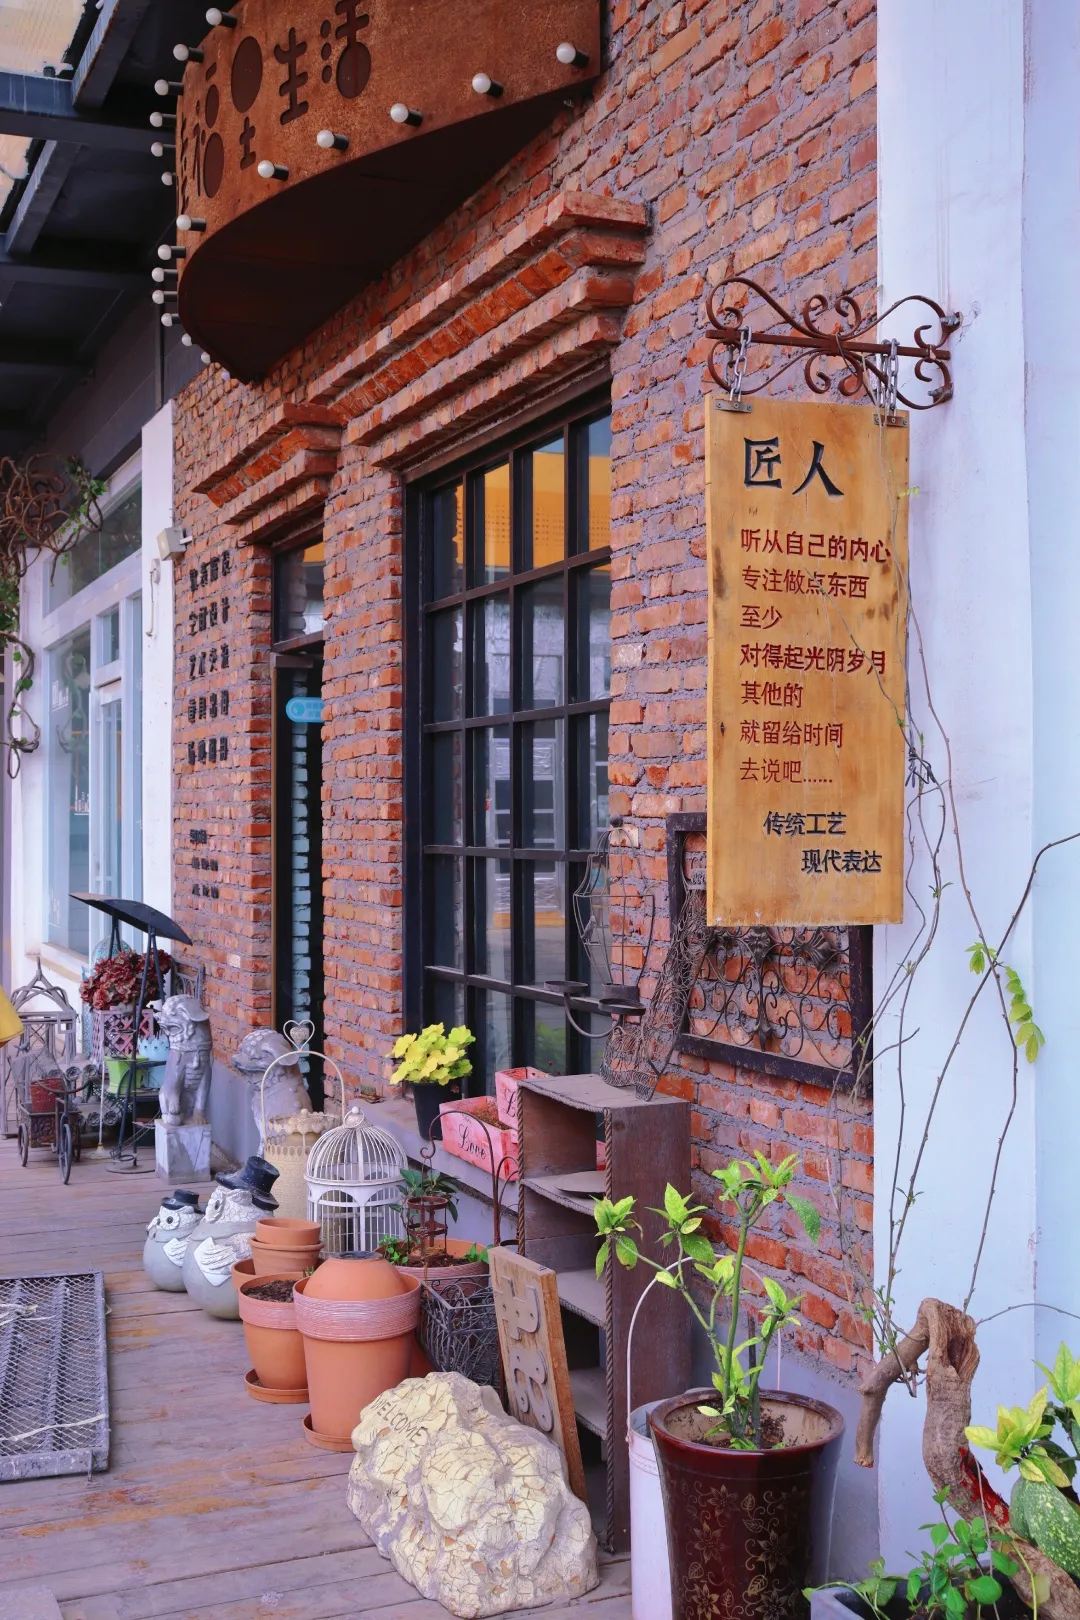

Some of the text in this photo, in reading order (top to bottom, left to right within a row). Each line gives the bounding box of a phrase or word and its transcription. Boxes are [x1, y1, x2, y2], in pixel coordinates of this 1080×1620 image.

[743, 436, 844, 497] 匠人
[740, 528, 891, 563] 听从自己的内心
[741, 565, 870, 599] 专注做点东西
[740, 605, 782, 630] 至少
[739, 643, 886, 675] 对得起光阴岁月
[741, 680, 803, 708] 其他的
[739, 719, 843, 748] 就留给时间
[763, 811, 847, 837] 传统工艺
[800, 849, 882, 874] 现代表达
[458, 1124, 487, 1160] Love
[369, 1396, 429, 1443] WELCOME
